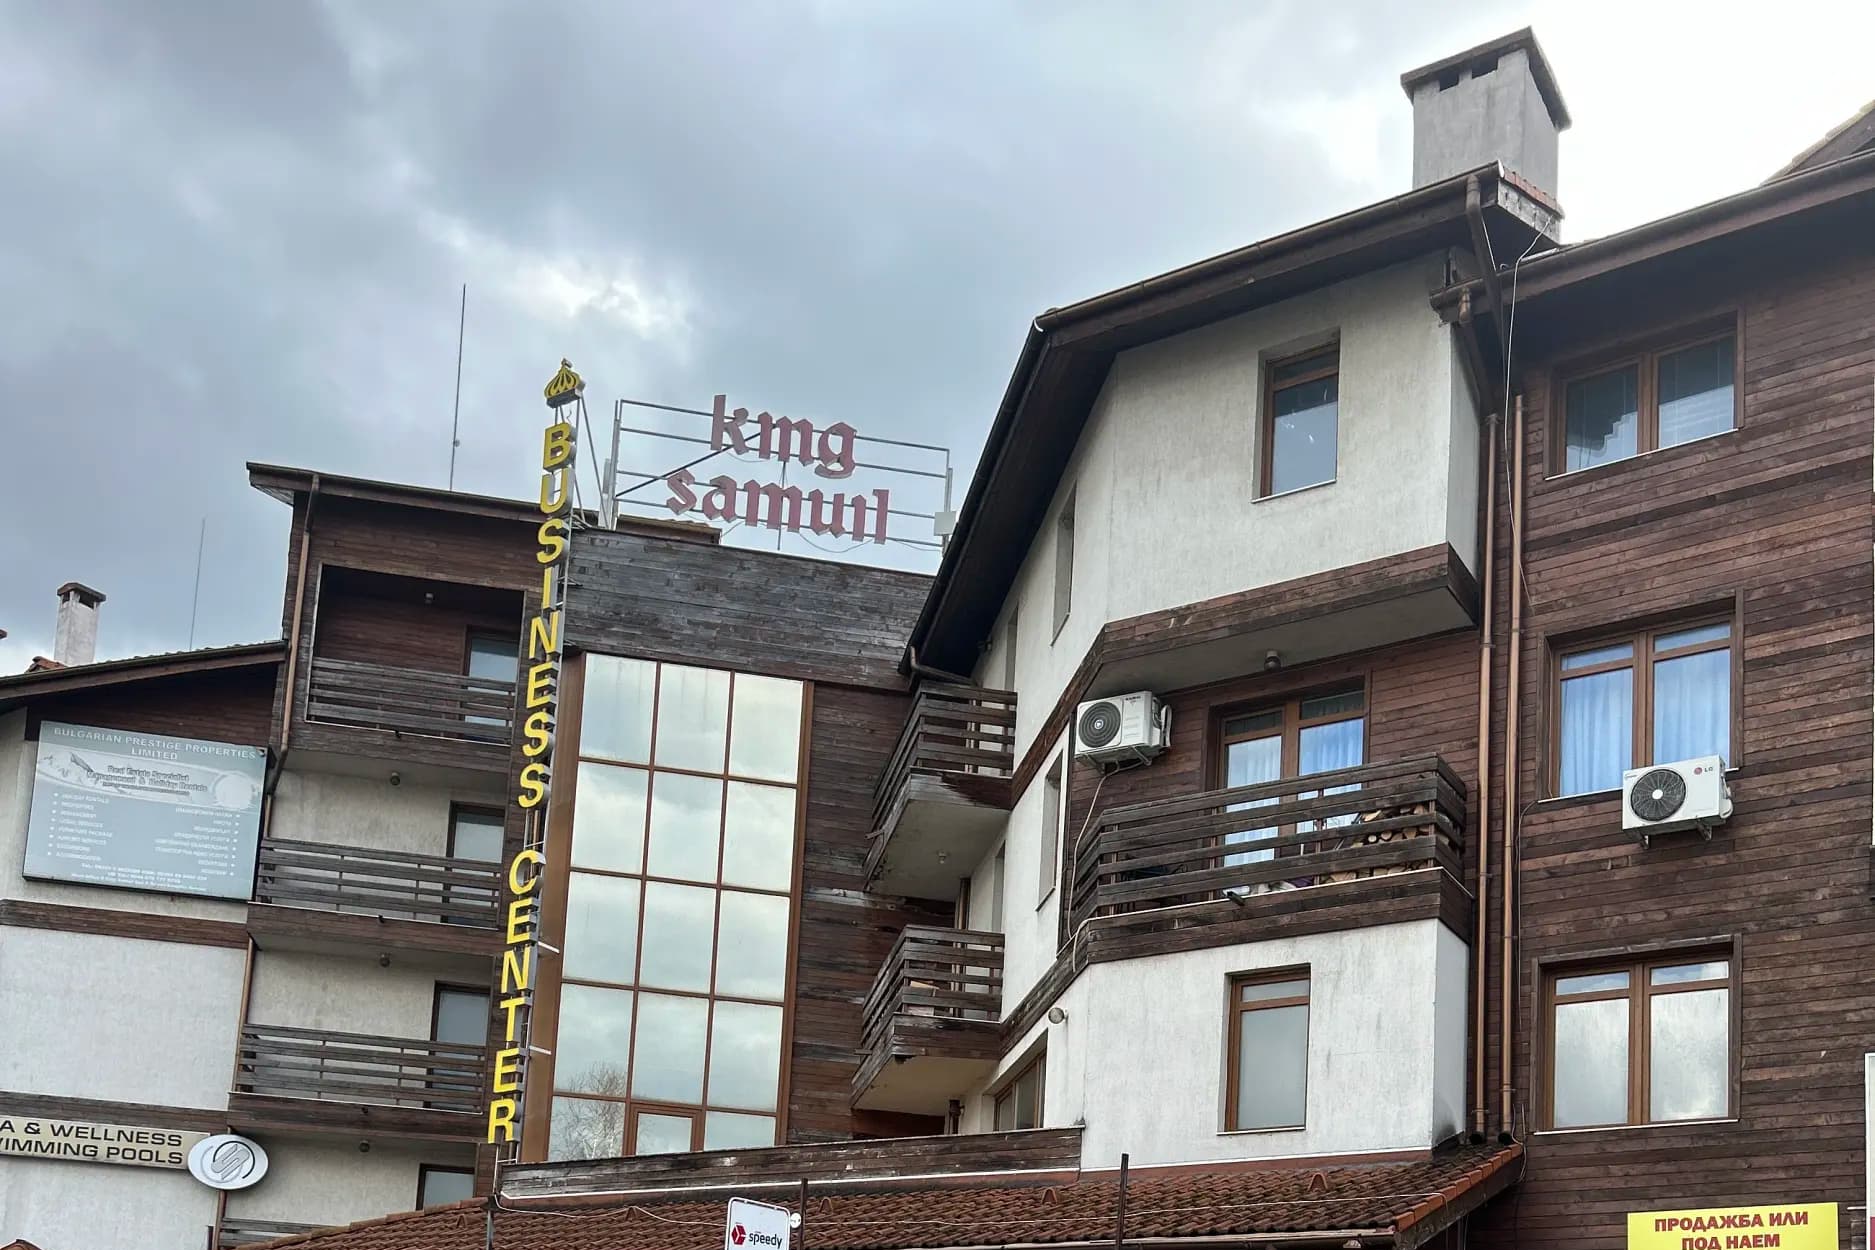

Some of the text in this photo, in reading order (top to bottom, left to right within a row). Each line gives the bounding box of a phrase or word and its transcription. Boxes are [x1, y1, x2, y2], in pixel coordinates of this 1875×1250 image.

[54, 727, 256, 760] BULGARIAN PRESTIGE PROPERTIES
[131, 747, 178, 761] LIMITED
[487, 422, 576, 1145] BUSINESS CENTER
[24, 1122, 40, 1135] &
[50, 1124, 183, 1146] WELLNESS
[0, 1138, 183, 1164] IMMING POOLS
[1654, 1211, 1809, 1233] ПРОДАЖБА ИЛИ
[748, 1231, 783, 1249] speedy
[1726, 1234, 1780, 1249] НАЕМ
